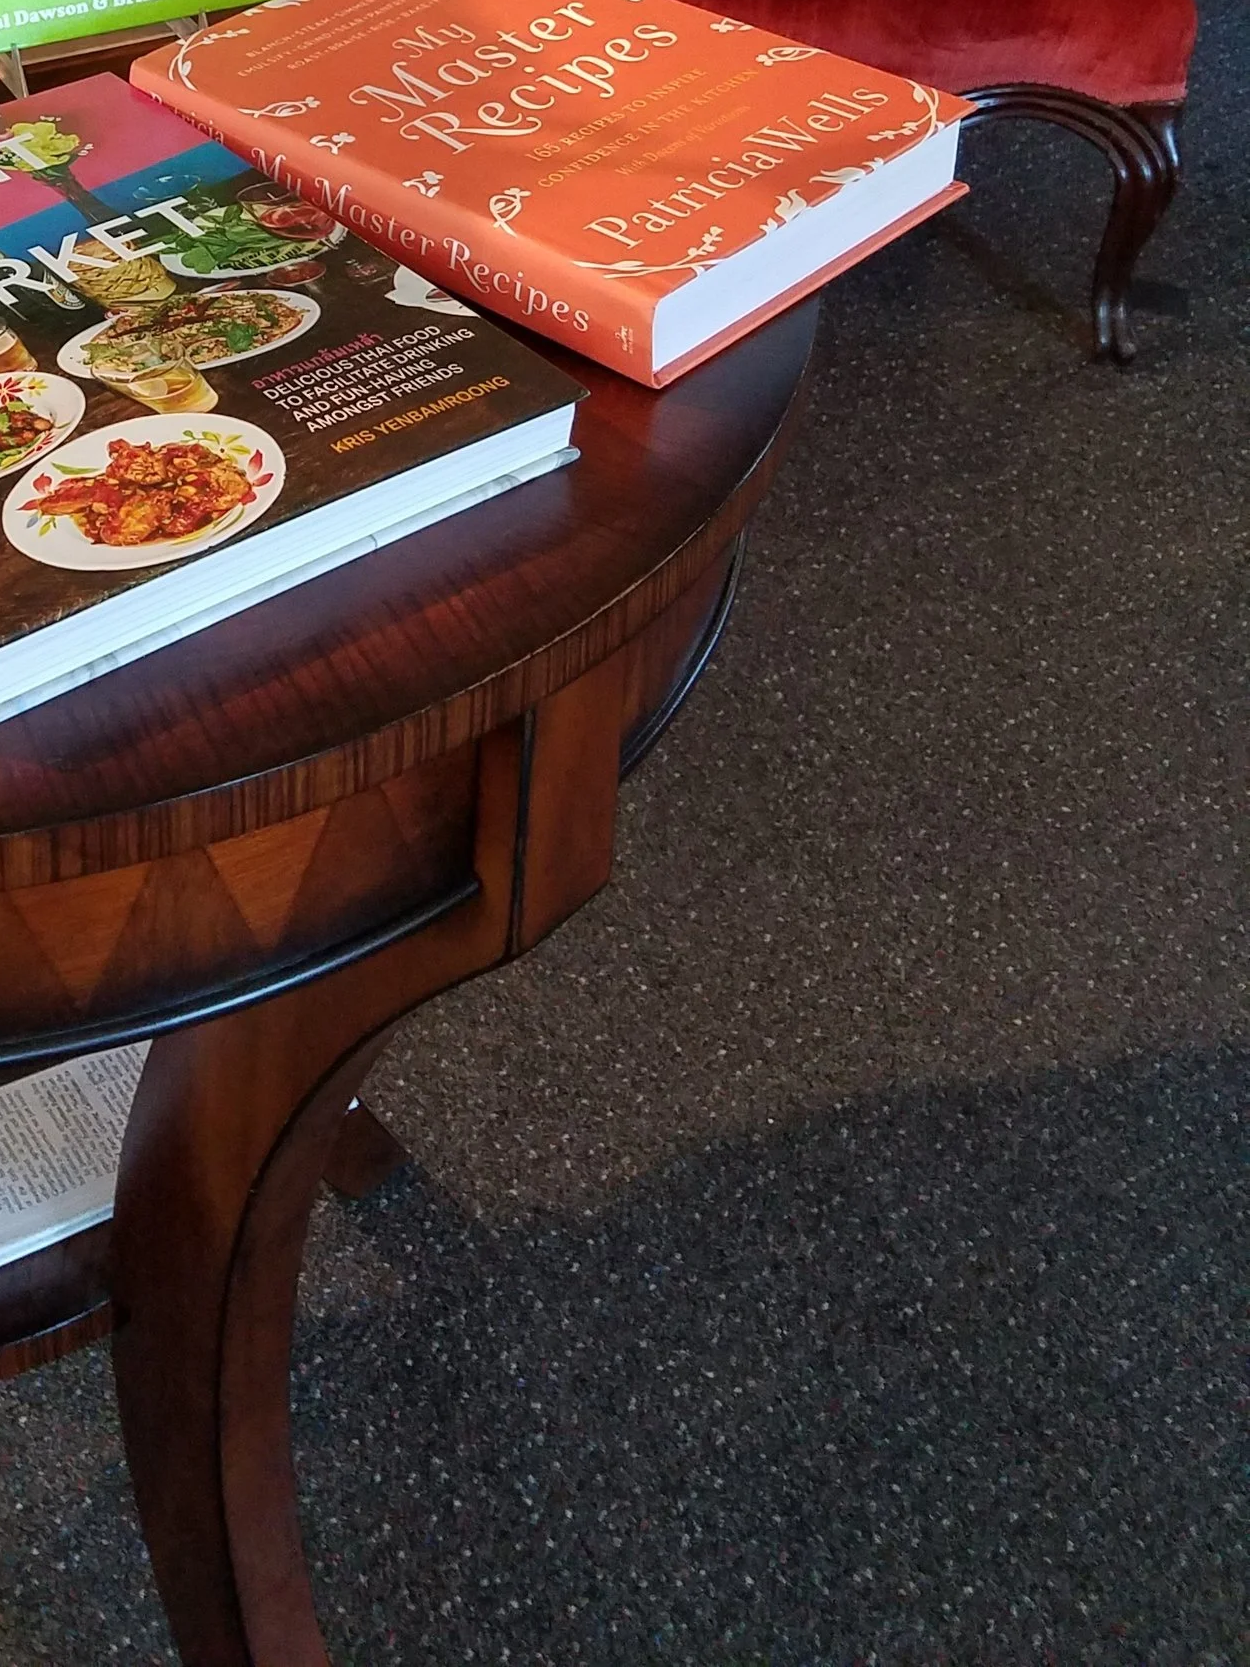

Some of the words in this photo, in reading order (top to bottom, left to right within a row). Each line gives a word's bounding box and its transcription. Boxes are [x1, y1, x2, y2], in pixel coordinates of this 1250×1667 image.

[14, 1, 89, 27] Dawson
[391, 22, 477, 59] My
[349, 0, 596, 124] Master
[399, 24, 679, 156] Recipes
[525, 142, 561, 163] 165
[560, 110, 626, 147] RECIPES
[622, 99, 647, 114] TO
[646, 68, 709, 102] INSPIRE
[537, 133, 640, 189] CONFIDENCE
[637, 121, 661, 135] IN
[658, 104, 694, 124] THE
[691, 68, 760, 108] KITCHEN
[582, 149, 784, 250] Patricia
[741, 87, 890, 153] Wells
[312, 177, 437, 257] Master
[442, 236, 593, 332] Recipes
[262, 359, 355, 401] DELICIOUS
[352, 344, 394, 366] THAI
[391, 325, 441, 349] FOOD
[275, 395, 304, 411] TO
[305, 358, 397, 401] FACILITATE
[393, 327, 476, 365] DRINKING
[292, 400, 331, 423] AND
[332, 358, 437, 405] FUN-HAVING
[305, 394, 392, 434] AMONGST
[390, 363, 466, 399] FRIENDS
[329, 430, 377, 455] KRIS
[374, 375, 511, 436] YENBAMROONG
